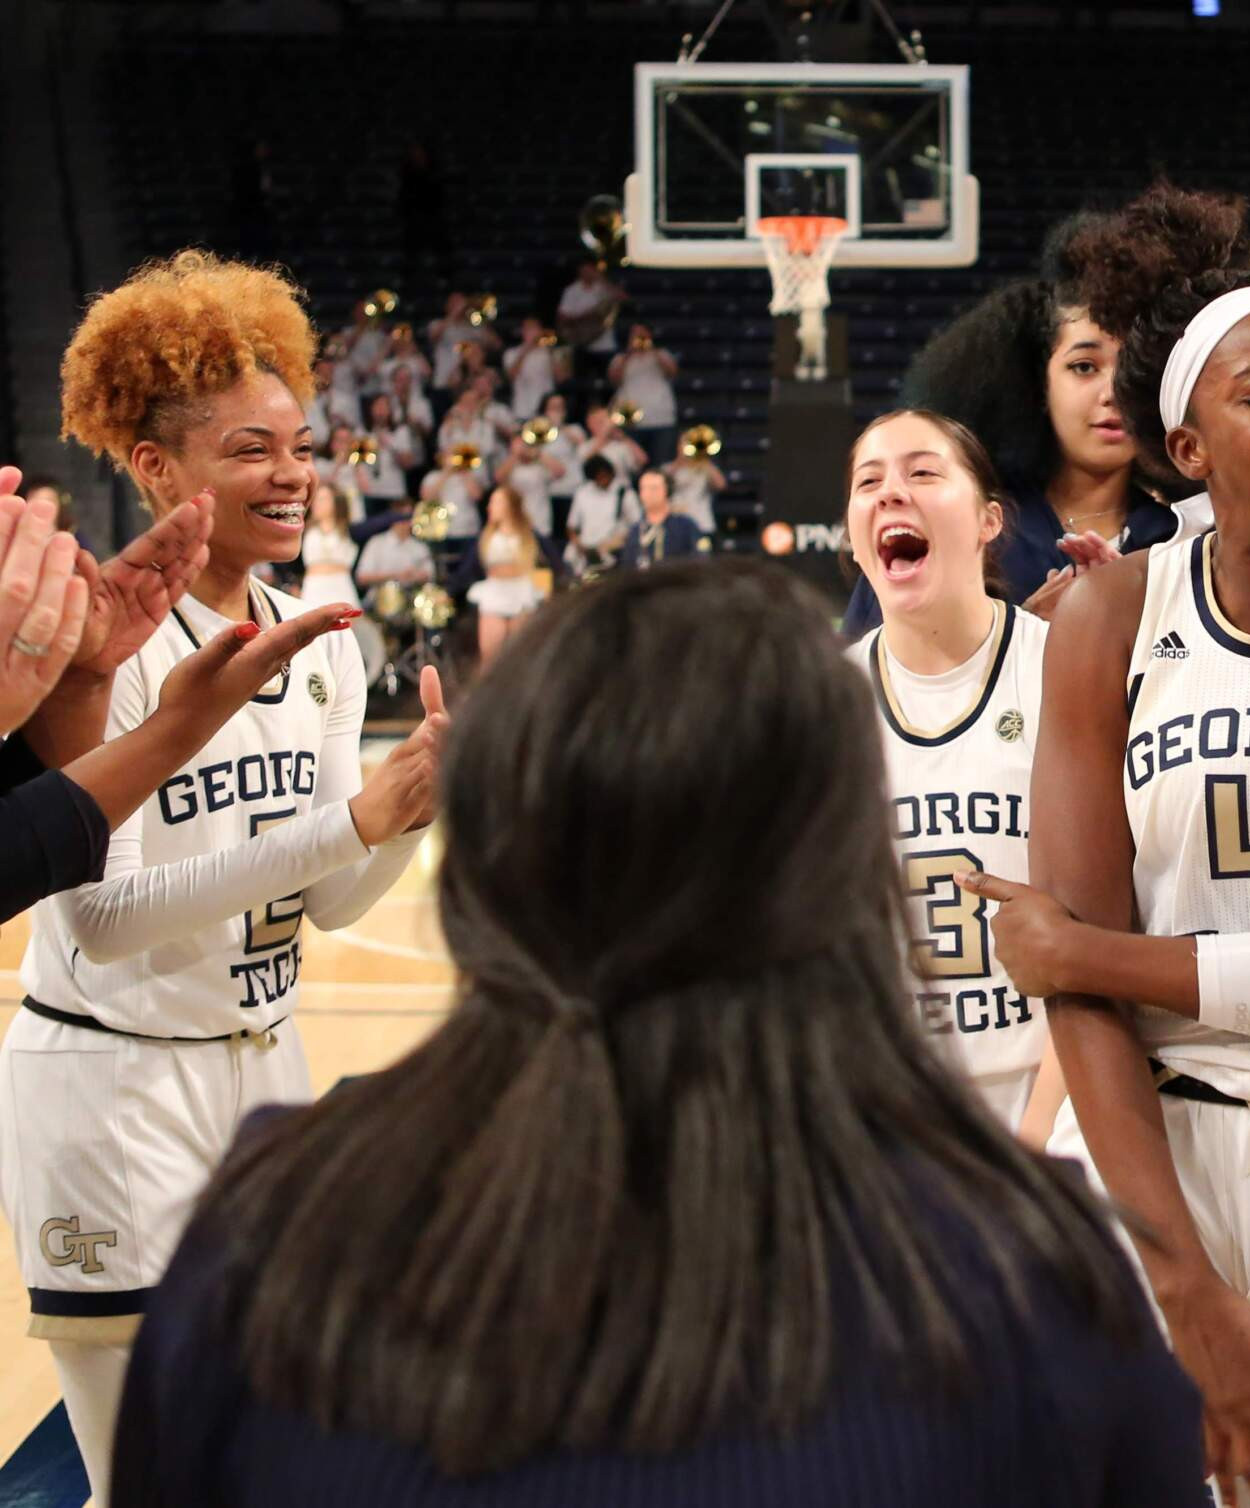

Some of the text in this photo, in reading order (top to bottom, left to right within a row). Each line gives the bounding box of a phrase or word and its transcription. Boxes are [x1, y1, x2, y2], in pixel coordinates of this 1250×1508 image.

[893, 792, 1029, 840] ORGI
[902, 847, 992, 980] 3
[39, 1216, 117, 1274] GT
